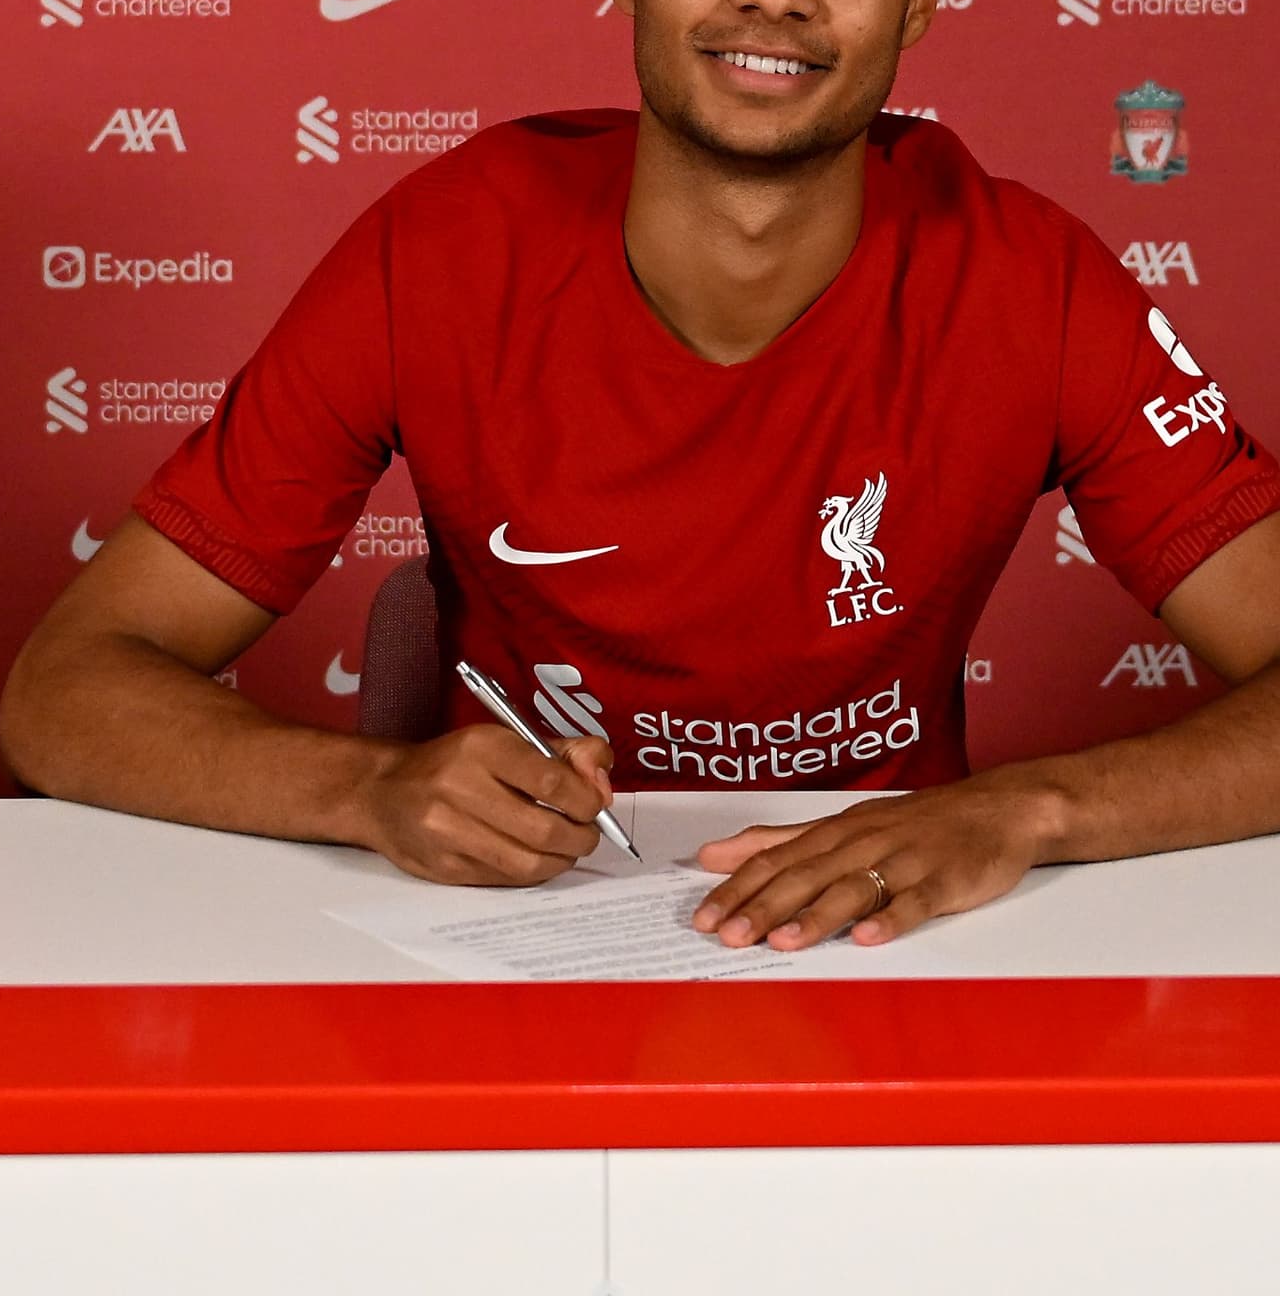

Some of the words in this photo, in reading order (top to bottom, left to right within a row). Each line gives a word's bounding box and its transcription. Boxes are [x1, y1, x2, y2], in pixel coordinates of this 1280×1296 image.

[88, 108, 186, 152] AXA
[351, 107, 478, 130] standard
[351, 130, 466, 152] chartere
[94, 252, 233, 289] Expedia
[100, 401, 216, 422] chartere
[826, 588, 904, 627] L.F.C.
[1099, 643, 1198, 687] AXA
[633, 679, 900, 748] standard
[637, 707, 920, 782] chartered
